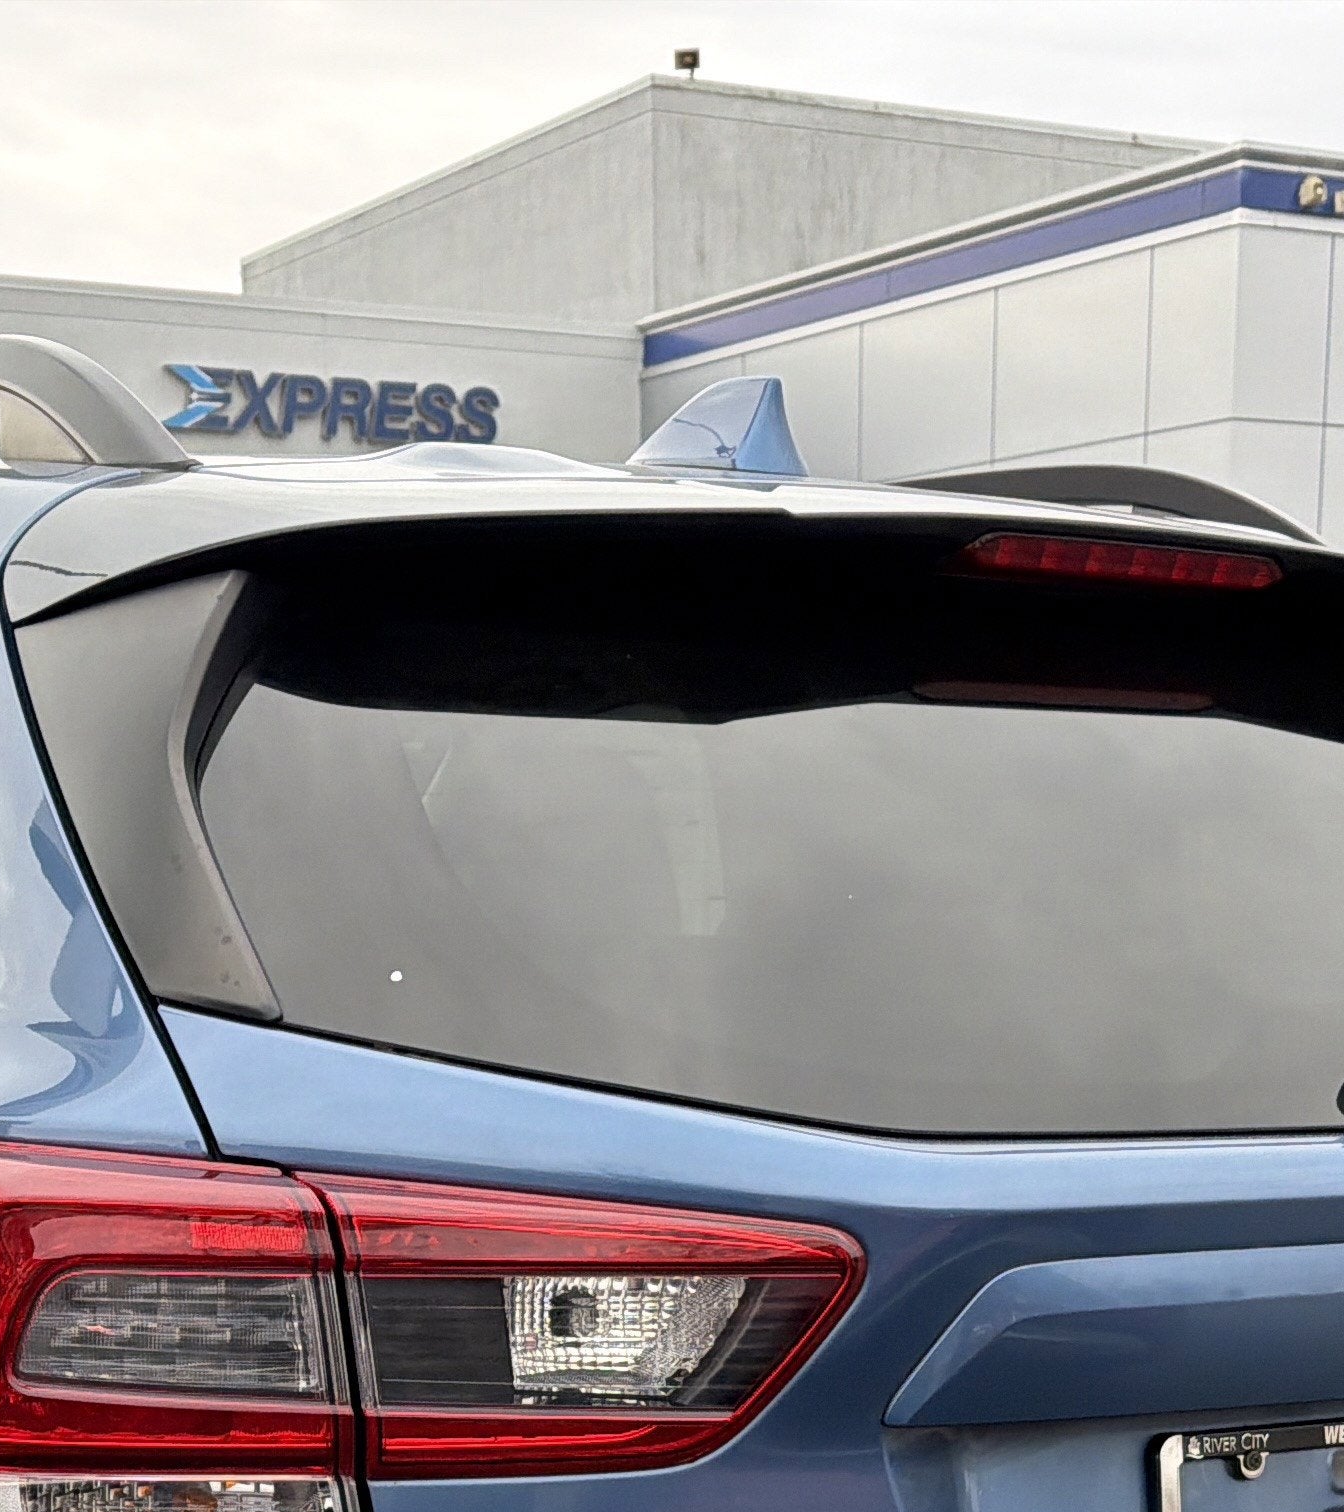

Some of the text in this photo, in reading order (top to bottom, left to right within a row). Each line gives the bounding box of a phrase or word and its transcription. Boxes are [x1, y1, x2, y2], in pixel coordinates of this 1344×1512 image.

[163, 363, 502, 446] EXPRESS
[1202, 1432, 1270, 1454] RIVER CITY
